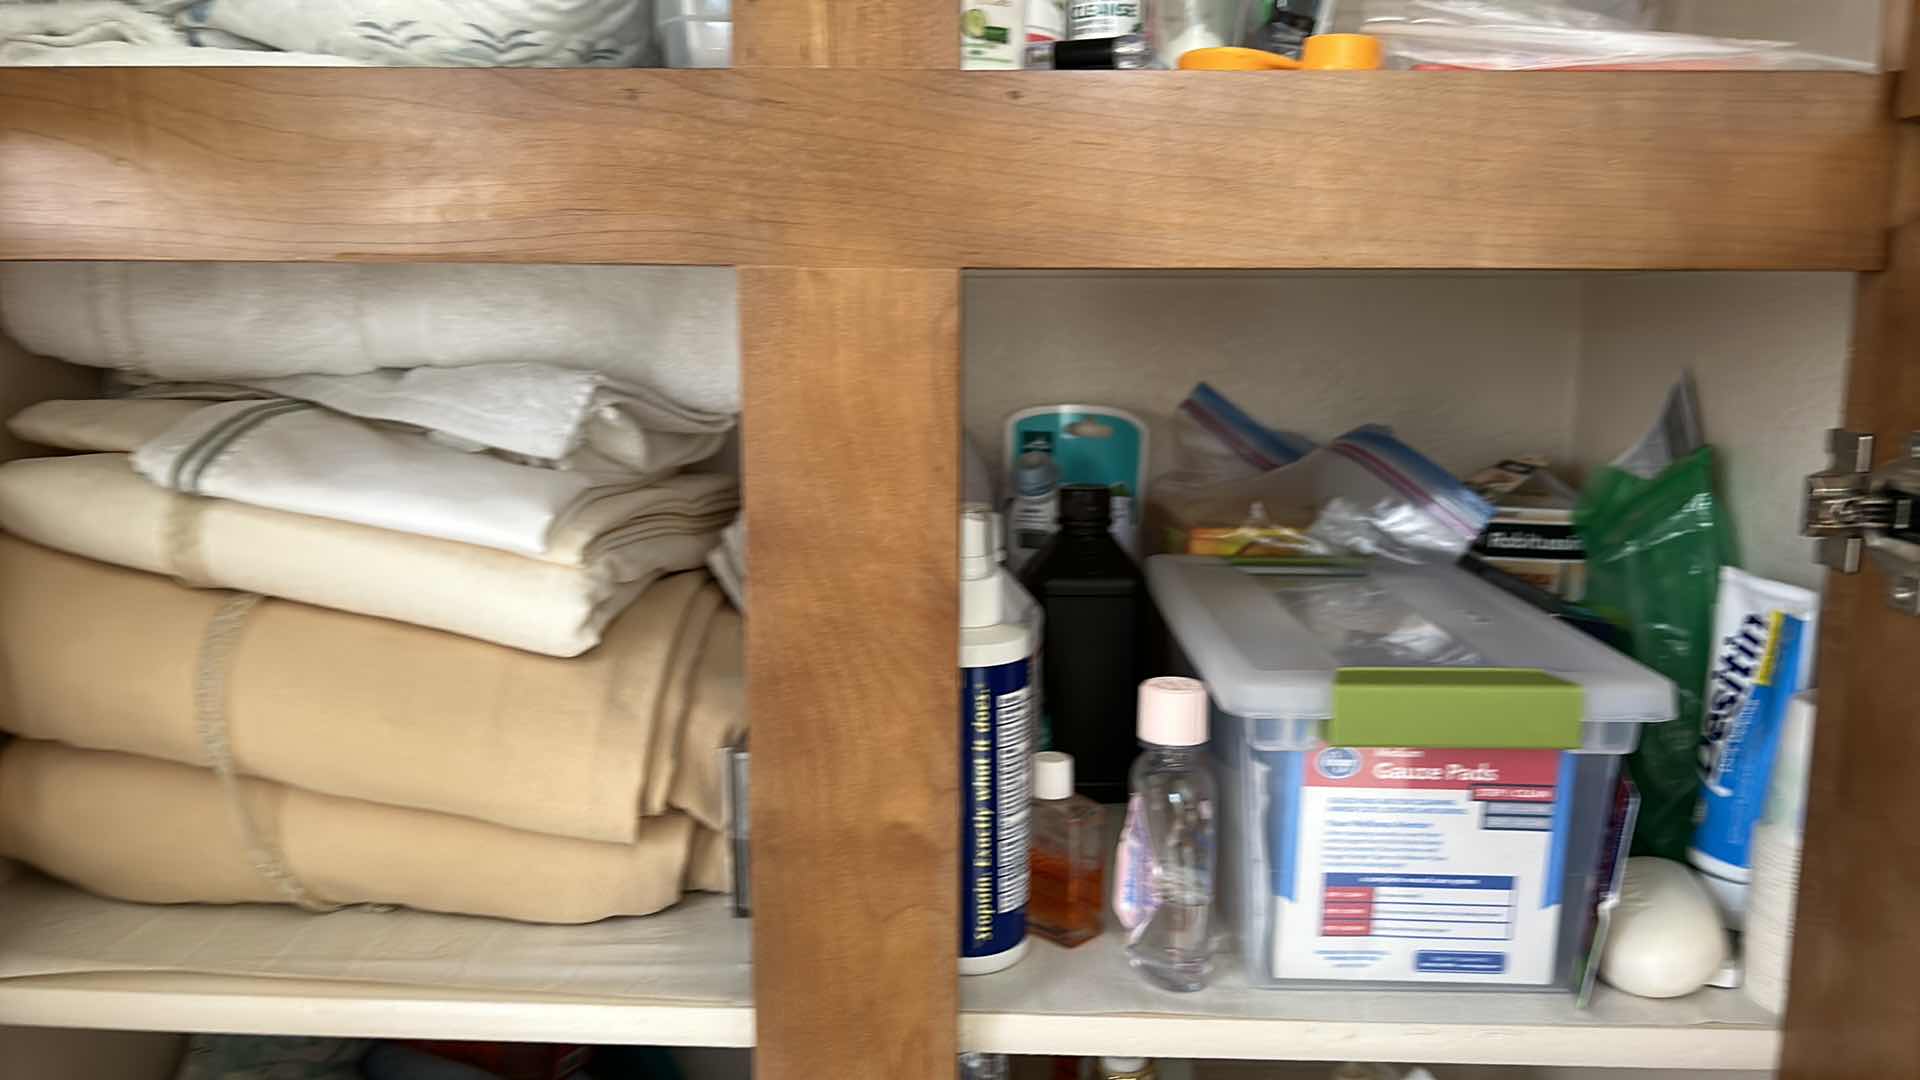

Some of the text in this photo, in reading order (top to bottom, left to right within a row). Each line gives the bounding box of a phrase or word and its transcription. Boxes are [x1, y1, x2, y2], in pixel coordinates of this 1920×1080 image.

[971, 739, 992, 752] it
[971, 758, 992, 801] what
[1444, 762, 1500, 782] Pads
[972, 807, 996, 868] Exactly
